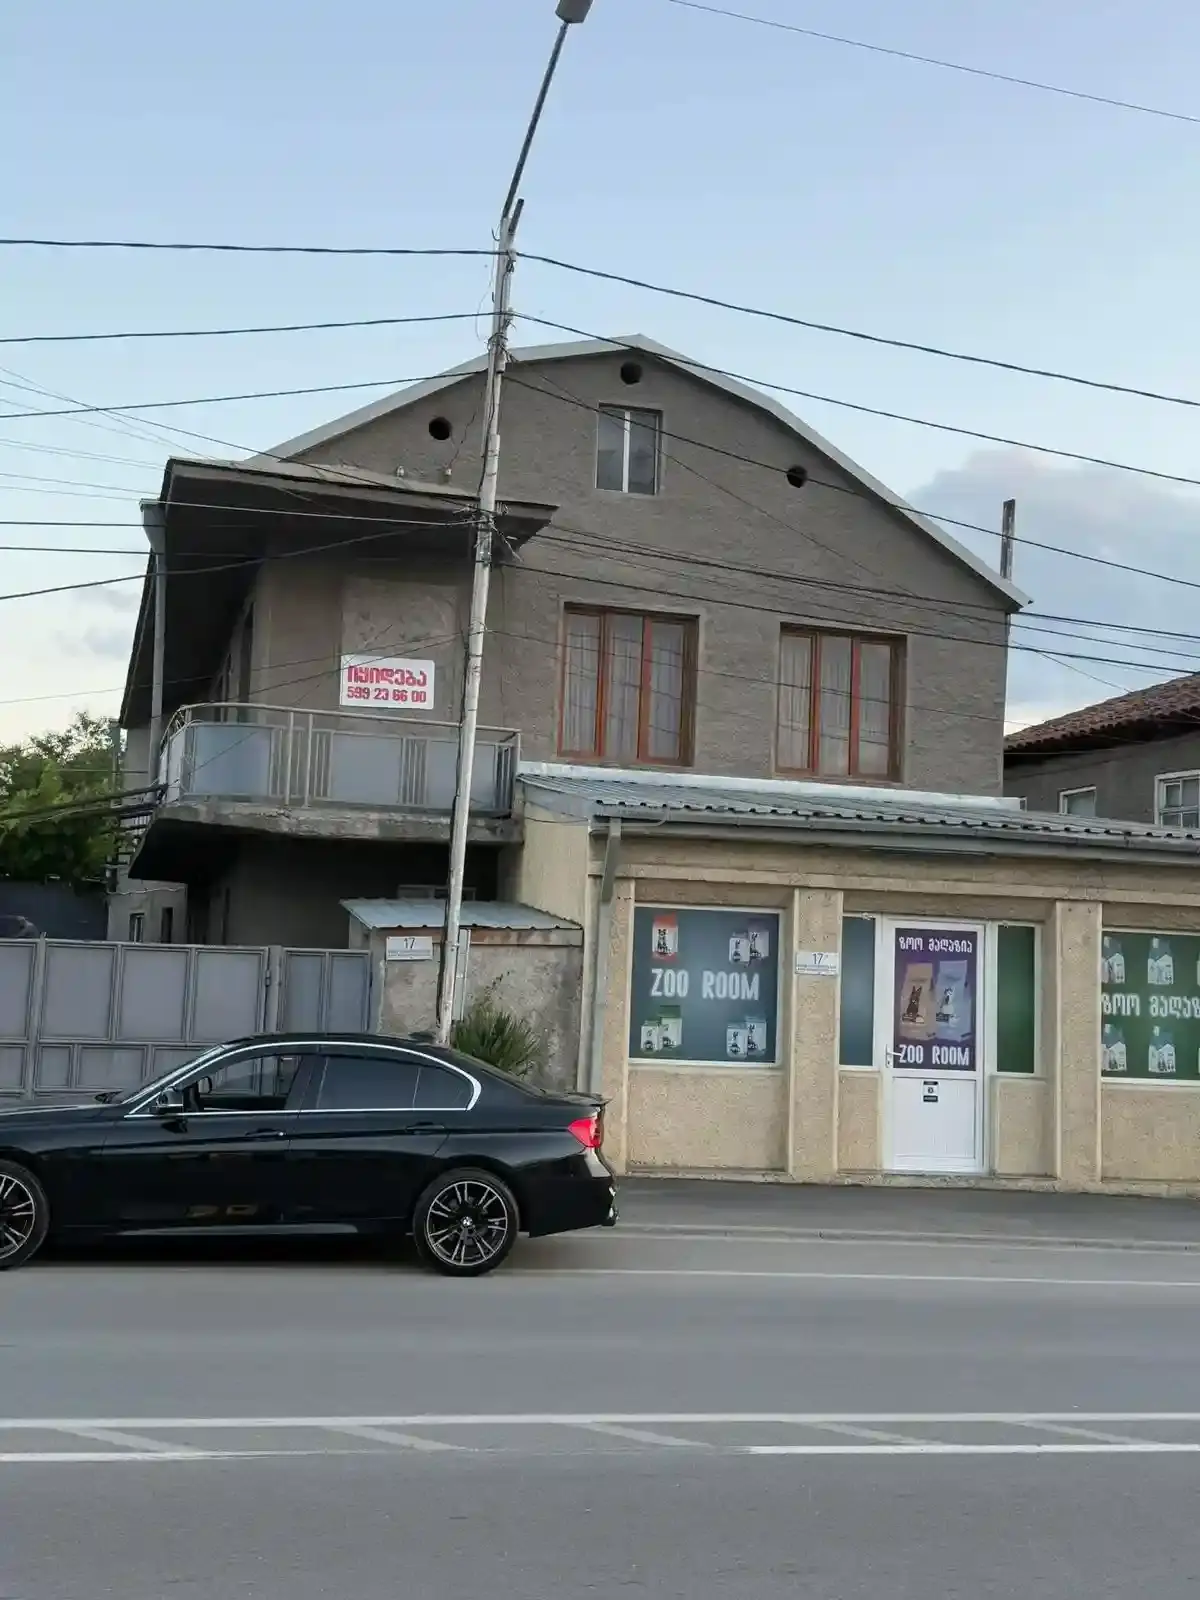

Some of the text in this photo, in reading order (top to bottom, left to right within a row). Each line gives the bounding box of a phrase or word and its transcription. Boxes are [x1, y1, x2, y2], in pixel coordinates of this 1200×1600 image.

[347, 665, 428, 687] იყიდება
[347, 687, 427, 703] 599 23 66 00
[403, 937, 416, 949] 17
[898, 936, 973, 954] ზოო მაღაზია
[812, 953, 824, 965] 17
[650, 968, 760, 1001] ZOO ROOM
[1101, 993, 1141, 1017] ზოო
[897, 1044, 970, 1066] ZOO ROOM
